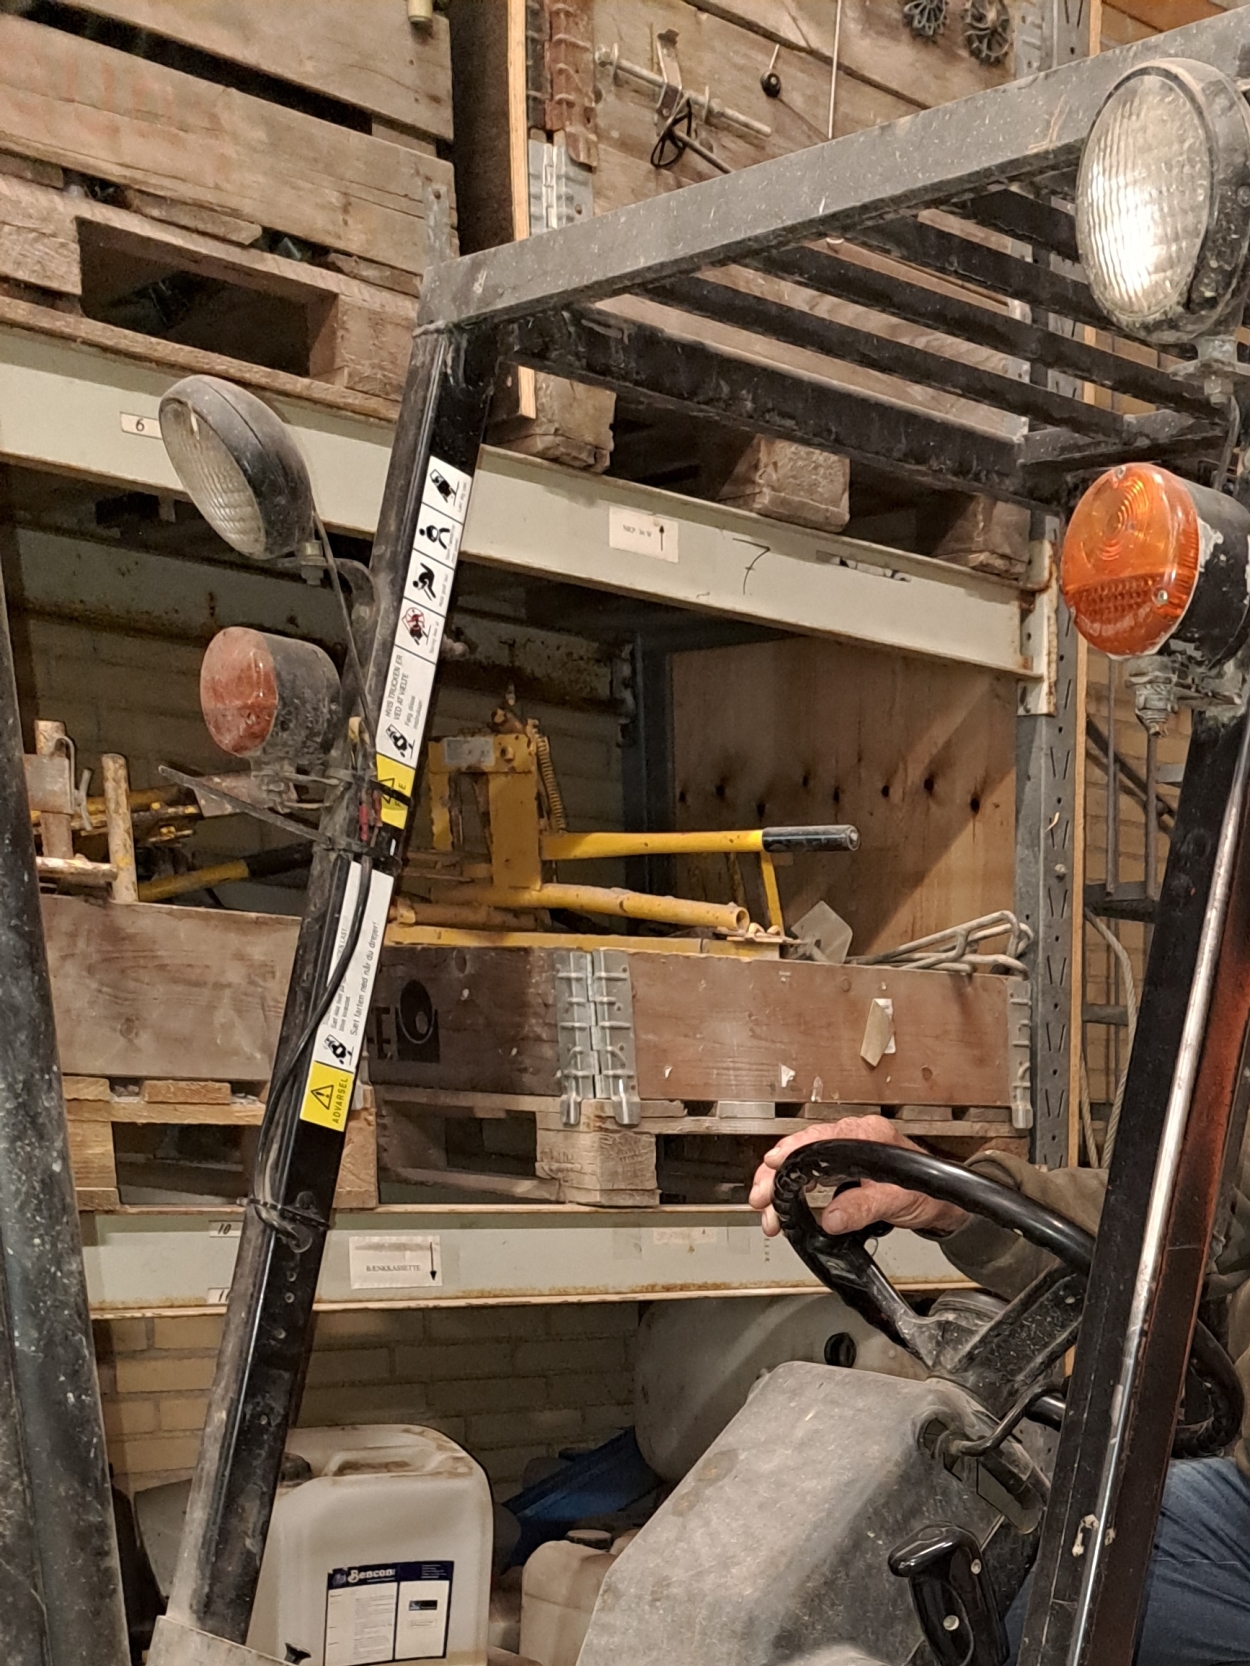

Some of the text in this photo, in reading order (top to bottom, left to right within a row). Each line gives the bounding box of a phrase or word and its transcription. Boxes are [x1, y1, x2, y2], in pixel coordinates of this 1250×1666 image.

[135, 418, 145, 432] 6
[388, 666, 400, 698] TRUCKEN
[385, 699, 394, 718] HVIS
[332, 1077, 348, 1124] ADVARSEL
[218, 1223, 232, 1235] 10
